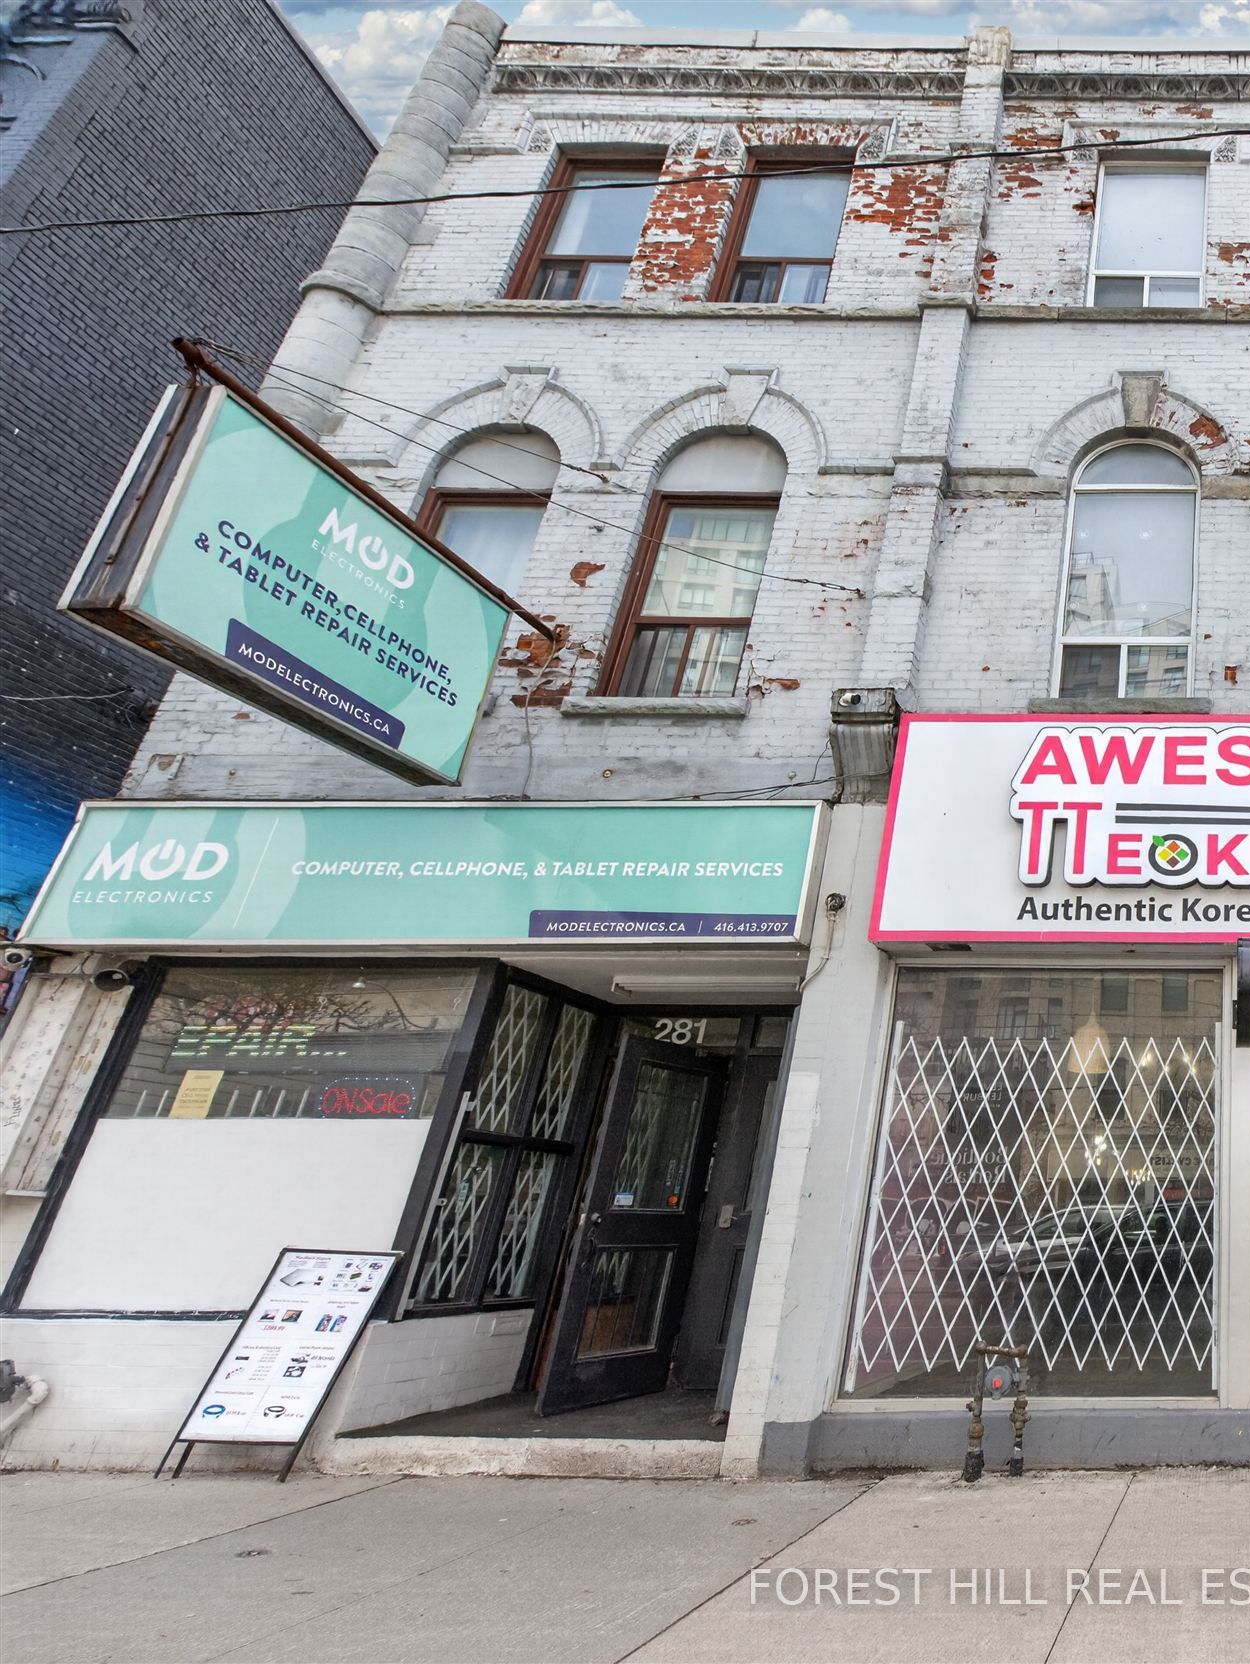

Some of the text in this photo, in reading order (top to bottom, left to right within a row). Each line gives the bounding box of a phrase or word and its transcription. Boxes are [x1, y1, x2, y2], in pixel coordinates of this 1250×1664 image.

[318, 507, 415, 590] MOD
[311, 539, 406, 610] ELECTRONICS
[194, 532, 458, 707] & TABLET REPAIR SERVICES
[238, 643, 390, 735] MODELECTRONICS.CA
[83, 839, 229, 881] MOD
[291, 861, 784, 880] COMPUTER, CELLPHONE, & TABLET REPAIR SERVICES
[72, 890, 214, 904] ELECTRONICS
[1017, 896, 1173, 922] Authentic
[546, 922, 686, 933] MODELECTRONICS.CA
[714, 922, 789, 934] 416.413.9707
[654, 1018, 707, 1045] 281
